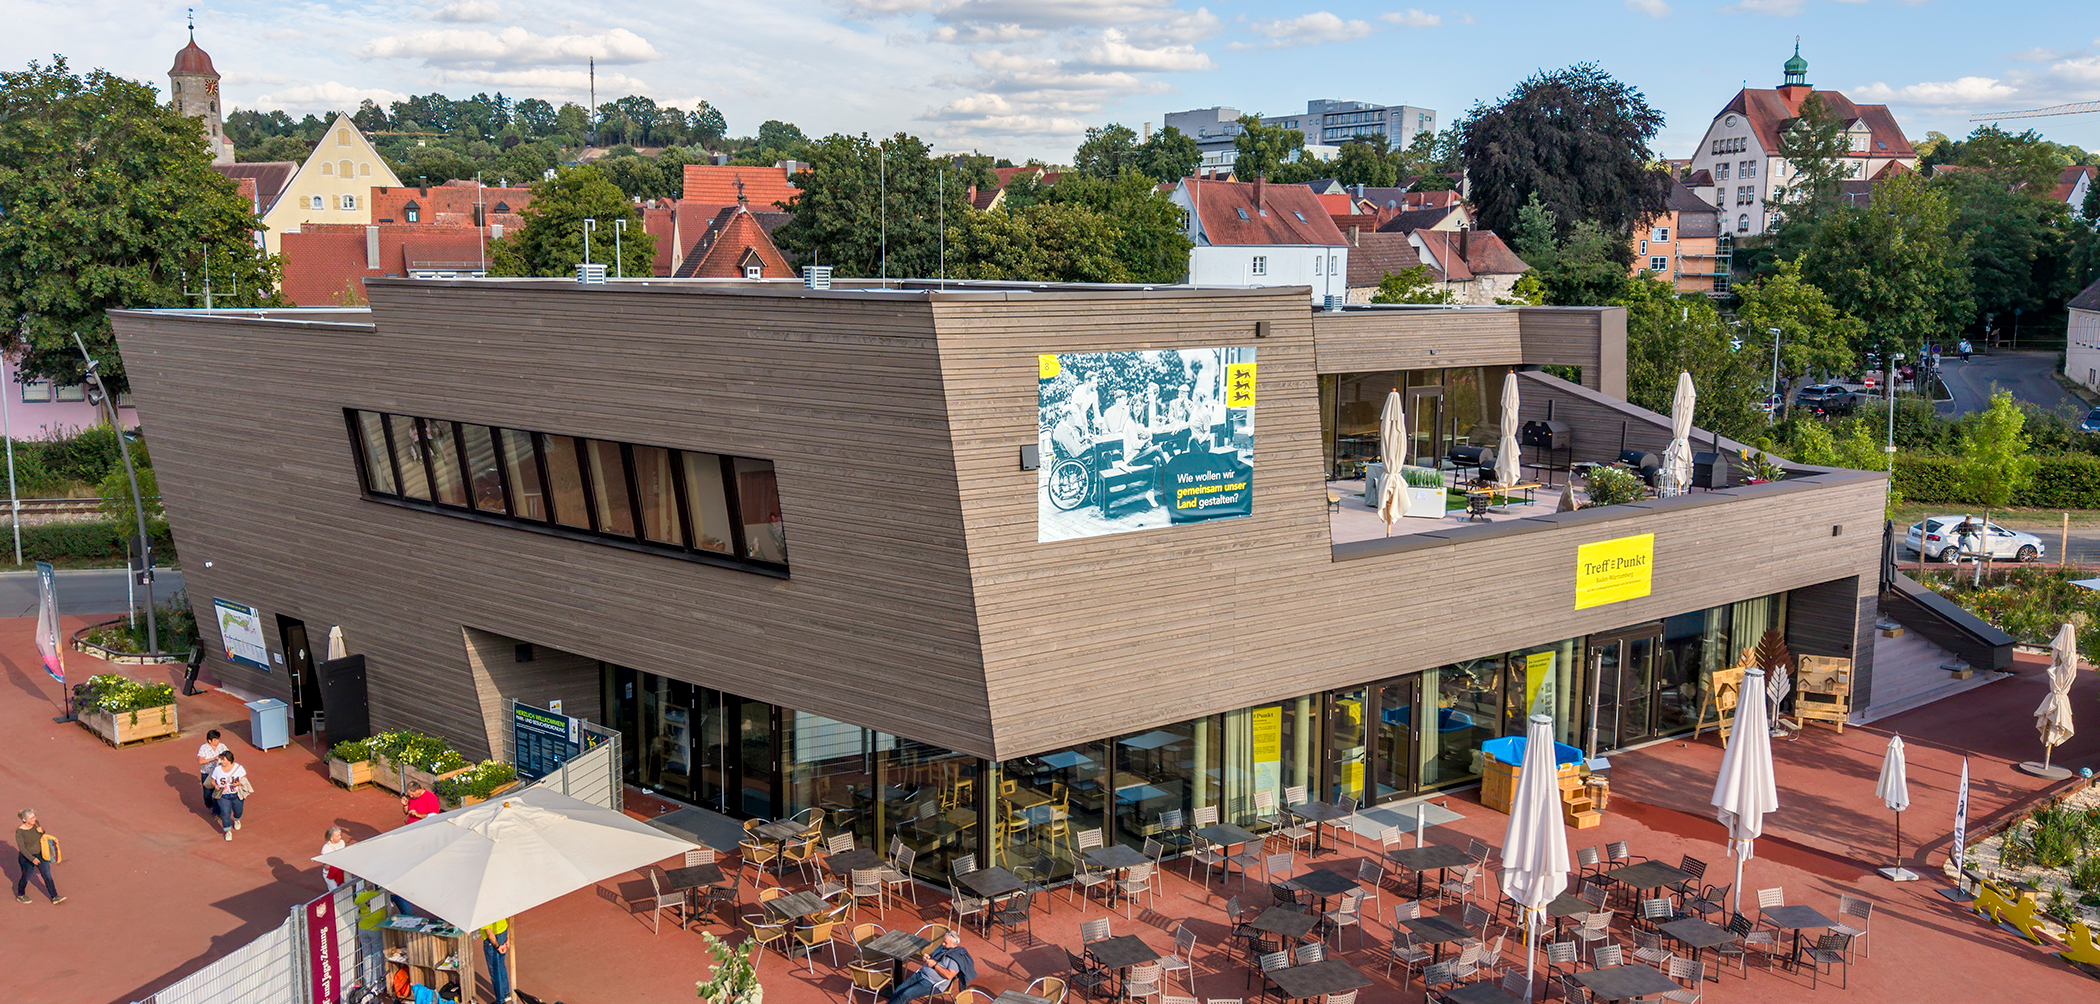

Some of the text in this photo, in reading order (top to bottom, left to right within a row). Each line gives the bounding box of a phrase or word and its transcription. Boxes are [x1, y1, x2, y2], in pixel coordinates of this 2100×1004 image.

[1044, 362, 1050, 371] 8
[1177, 469, 1235, 483] Wie wollen wir
[1177, 482, 1247, 499] gemeinsam unser
[1177, 493, 1239, 509] Land gestalten?
[1585, 555, 1645, 575] Treff Punkt
[322, 981, 331, 998] und
